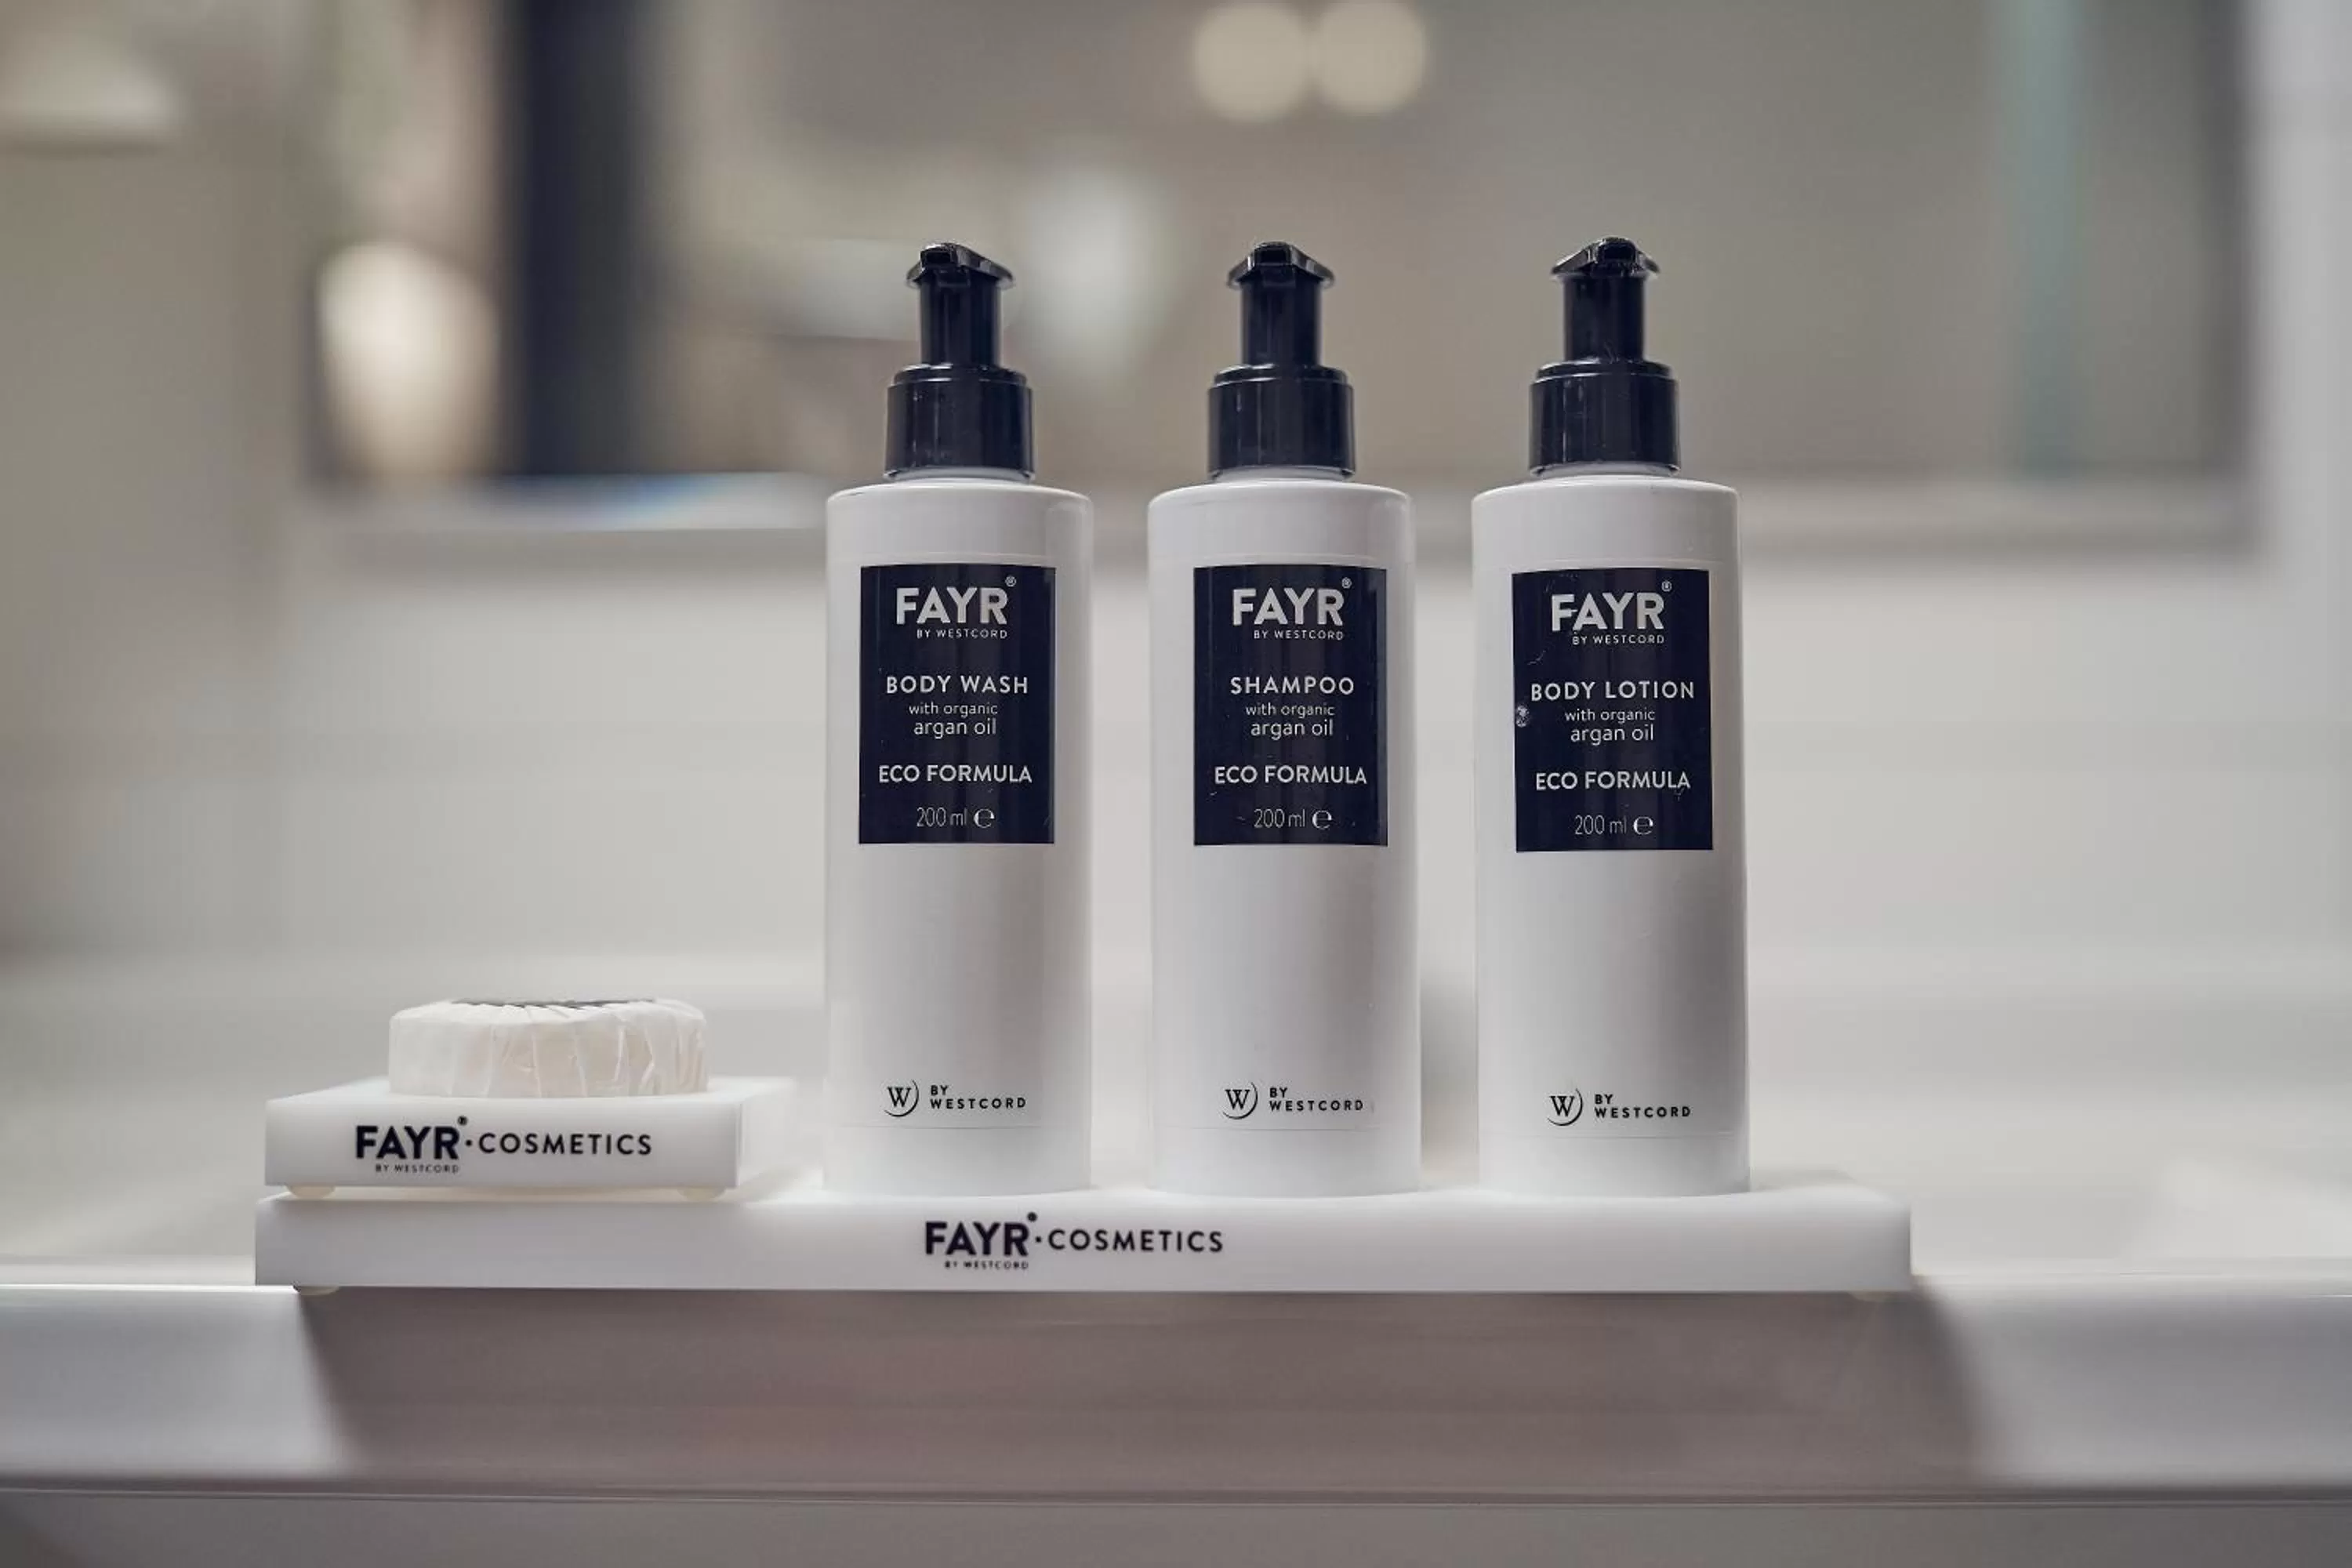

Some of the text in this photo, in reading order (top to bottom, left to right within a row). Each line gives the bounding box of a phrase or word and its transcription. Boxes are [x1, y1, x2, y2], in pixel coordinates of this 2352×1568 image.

[916, 629, 1007, 639] BY WESTCORD
[1254, 630, 1344, 641] BY WESTCORD
[1572, 634, 1664, 645] BY WESTCORD
[887, 676, 1029, 694] BODY WASH
[1230, 677, 1355, 695] SHAMPOO
[1531, 681, 1695, 701] BODY LOTION
[909, 702, 998, 718] with organic
[1245, 703, 1335, 719] with organic
[1565, 709, 1656, 724] with organic
[913, 718, 996, 739] argan oil
[1250, 720, 1334, 740] argan oil
[1570, 724, 1653, 746] argan oil
[879, 765, 1033, 783] ECO FORMULA
[1214, 765, 1367, 785] ECO FORMULA
[1536, 771, 1691, 791] ECO FORMULA
[916, 808, 946, 827] 200
[949, 808, 967, 826] ml
[1254, 809, 1284, 829] 200
[1288, 809, 1305, 827] ml
[1574, 815, 1605, 835] 200
[1609, 815, 1627, 833] ml
[887, 1087, 911, 1107] W
[930, 1085, 949, 1096] BY
[1225, 1089, 1250, 1109] W
[1269, 1087, 1288, 1098] BY
[1594, 1094, 1613, 1105] BY
[930, 1098, 1026, 1109] WESTCORD
[1269, 1100, 1363, 1111] WESTCORD
[1551, 1095, 1574, 1116] W
[1594, 1106, 1691, 1118] WESTCORD
[479, 1133, 652, 1156] COSMETICS
[376, 1164, 459, 1174] BY WESTCORD
[1048, 1229, 1222, 1253] COSMETICS
